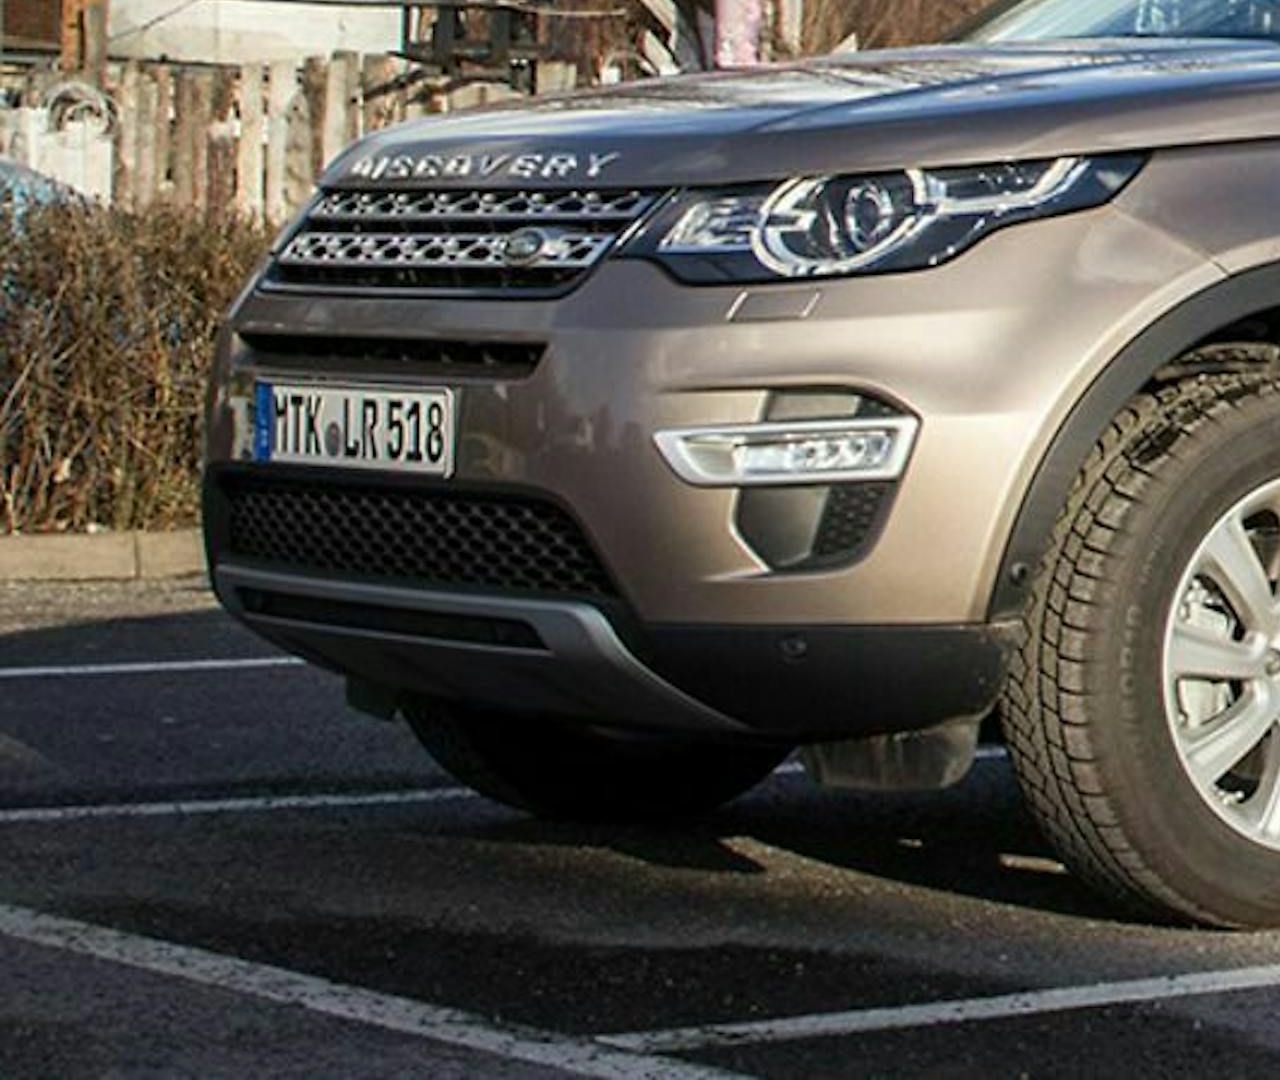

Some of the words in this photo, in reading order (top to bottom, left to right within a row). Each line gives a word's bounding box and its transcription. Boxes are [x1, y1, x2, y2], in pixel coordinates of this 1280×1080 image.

[351, 152, 619, 178] DISCOVERY
[343, 398, 378, 459] LR
[386, 400, 444, 463] 518
